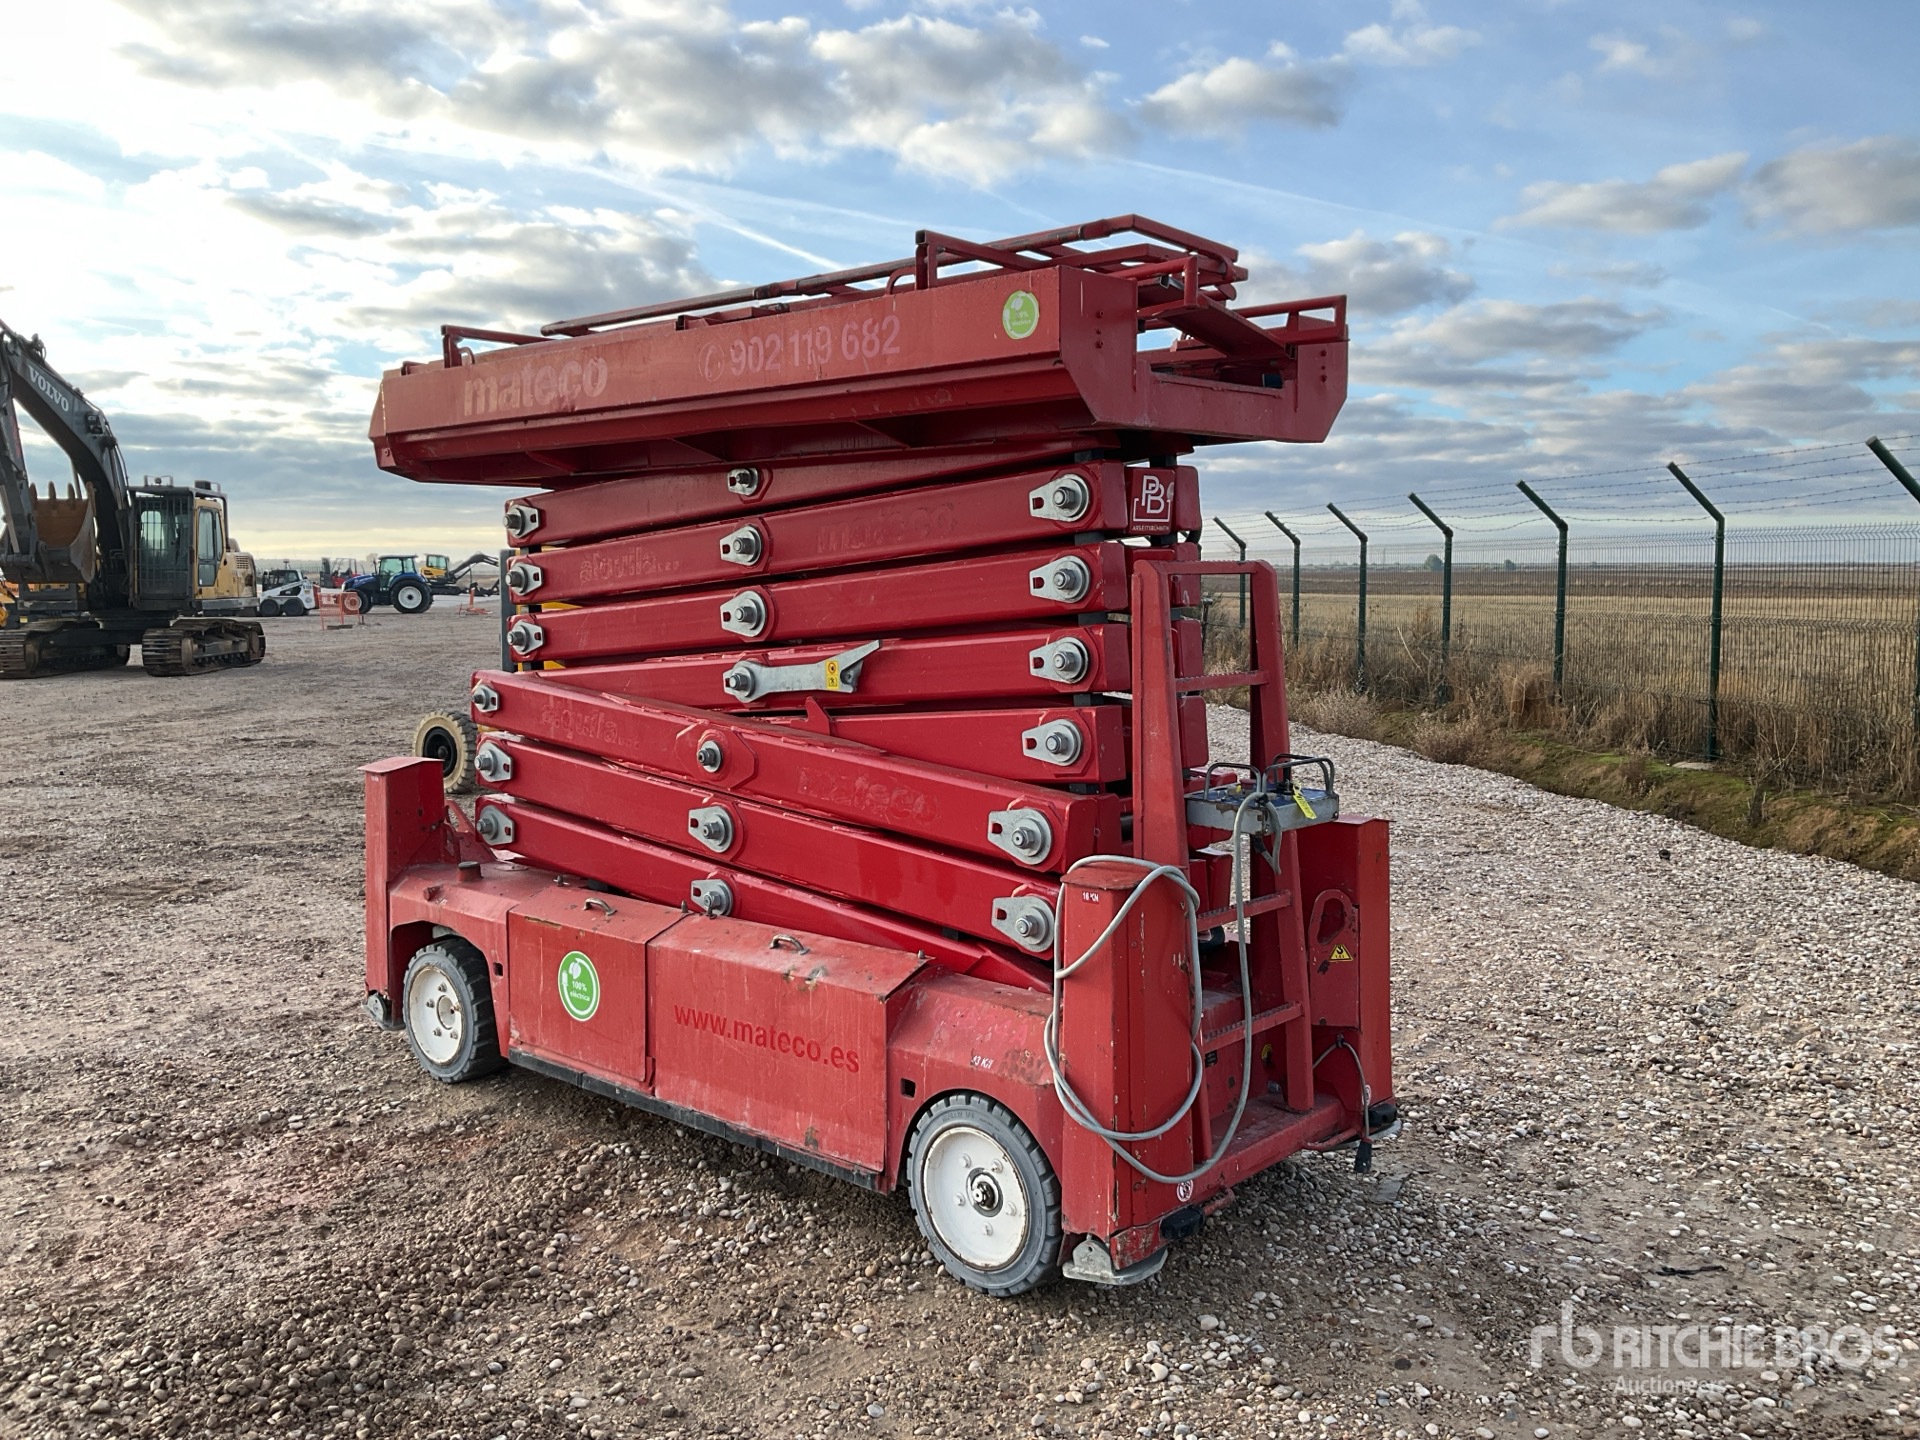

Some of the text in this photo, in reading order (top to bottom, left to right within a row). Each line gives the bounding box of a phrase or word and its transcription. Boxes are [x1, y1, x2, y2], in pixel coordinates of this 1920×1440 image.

[730, 315, 901, 376] 902 119 682
[28, 364, 69, 412] VOLVO
[464, 356, 608, 417] mateco
[572, 980, 588, 992] 100%
[673, 1004, 860, 1074] www.mateco.es
